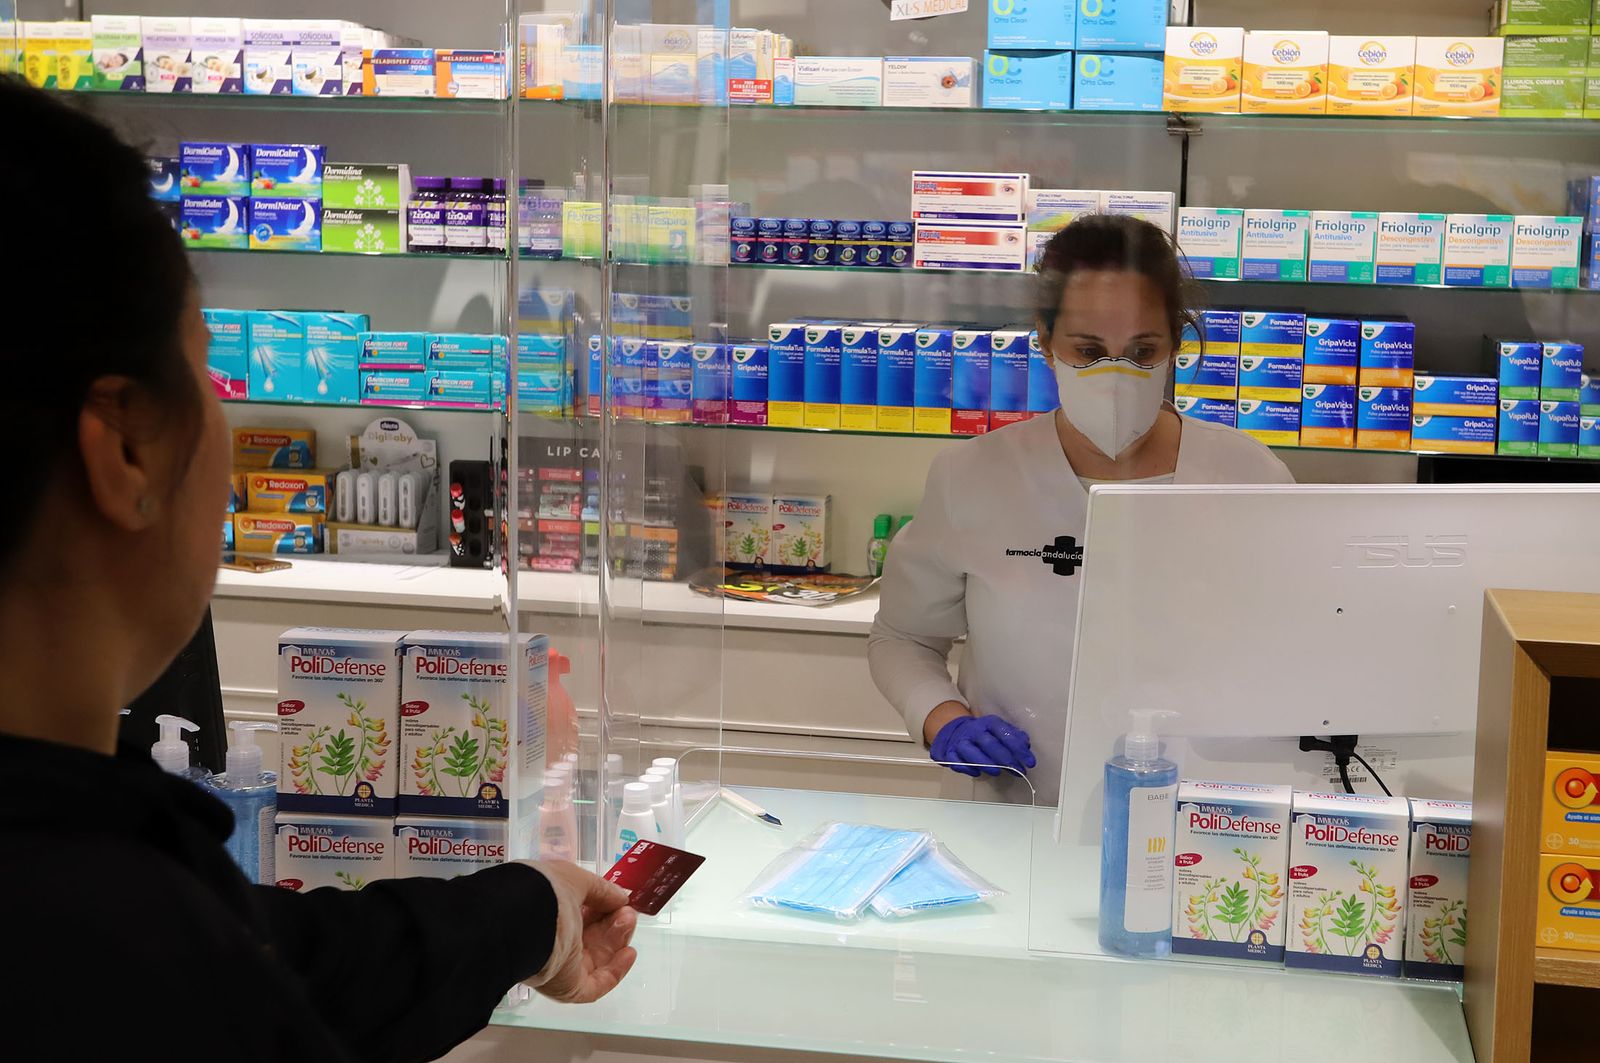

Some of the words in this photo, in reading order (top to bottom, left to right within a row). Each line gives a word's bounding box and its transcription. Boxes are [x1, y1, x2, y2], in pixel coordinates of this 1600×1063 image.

[250, 32, 284, 41] SOÑODINA
[299, 32, 333, 41] SOÑODINA
[1190, 40, 1218, 50] Cebión
[1272, 48, 1300, 57] Cebión
[1358, 50, 1387, 58] Cebión
[1446, 50, 1474, 60] Cebión
[184, 146, 223, 156] DormiCalm
[256, 148, 299, 158] DormiCalm
[324, 166, 363, 176] Dormidina
[184, 198, 222, 208] DormiCalm
[254, 200, 302, 211] DormiNatur
[324, 210, 362, 220] Dormidina
[1180, 216, 1230, 230] Friolgrip
[1247, 218, 1297, 231] Friolgrip
[1315, 220, 1366, 233] Friolgrip
[1381, 222, 1432, 234] Friolgrip
[1449, 223, 1501, 236] Friolgrip
[1517, 225, 1570, 238] Friolgrip
[1314, 233, 1352, 241] Antitusivo
[1206, 317, 1239, 325] FormulaTus
[1270, 318, 1303, 326] FormulaTus
[1318, 338, 1356, 347] GripaVicks
[1374, 341, 1412, 350] GripaVicks
[770, 344, 804, 352] FormulaTus
[842, 347, 877, 355] FormulaTus
[879, 348, 914, 356] FormulaTus
[916, 349, 951, 357] FormulaTus
[992, 352, 1028, 360] FormulaExpec
[1203, 360, 1236, 368] FormulaTus
[1509, 357, 1539, 366] VapoRub
[1551, 358, 1582, 368] VapoRub
[1466, 384, 1496, 392] GripaDuo
[1201, 403, 1234, 411] FormulaTus
[1315, 400, 1353, 409] GripaVicks
[1371, 403, 1409, 412] GripaVicks
[1508, 412, 1538, 422] VapoRub
[1548, 414, 1579, 423] VapoRub
[1464, 420, 1494, 428] GripaDuo
[252, 436, 288, 444] Redoxon
[547, 445, 572, 456] LIP
[580, 448, 622, 461] CAE
[269, 480, 304, 489] Redoxon
[727, 502, 769, 512] PoliDefense
[779, 505, 822, 514] PoliDefense
[256, 521, 291, 530] Redoxon
[291, 656, 386, 676] PoliDefense
[1190, 812, 1281, 834] PoliDefense
[1305, 824, 1399, 846] PoliDefense
[288, 834, 384, 855] PoliDefense
